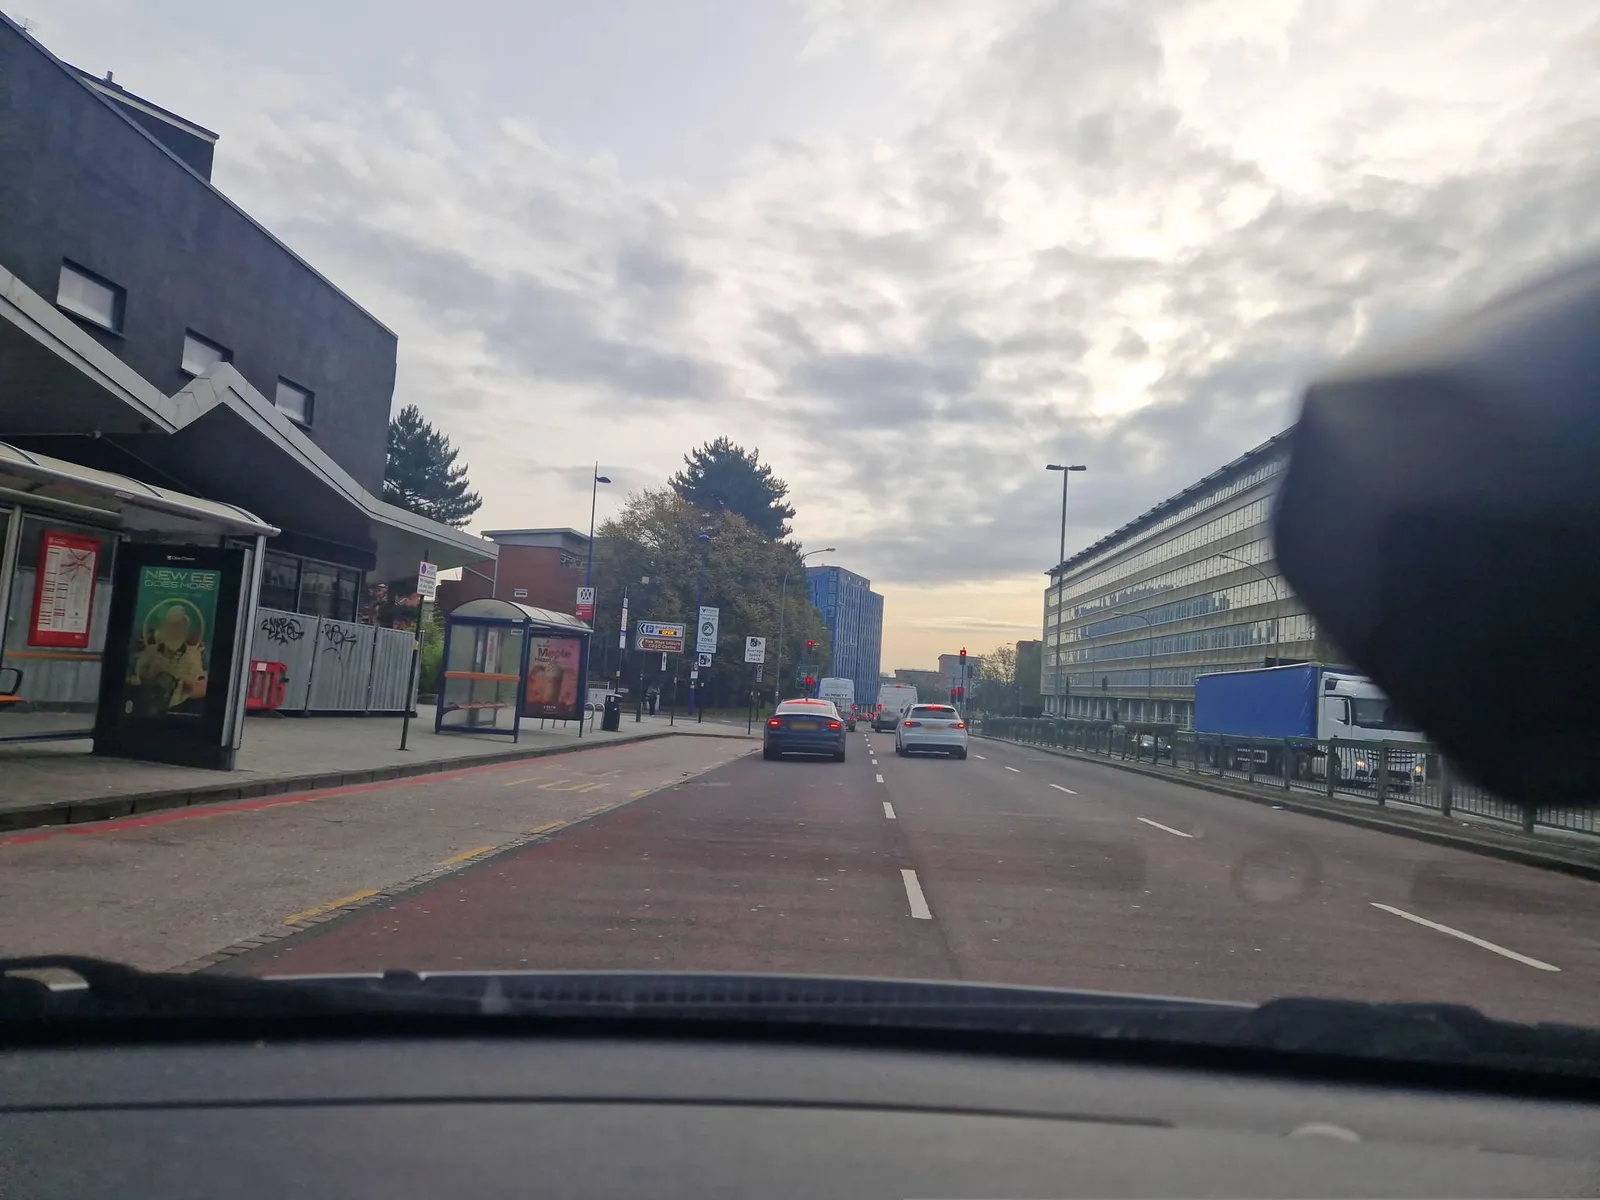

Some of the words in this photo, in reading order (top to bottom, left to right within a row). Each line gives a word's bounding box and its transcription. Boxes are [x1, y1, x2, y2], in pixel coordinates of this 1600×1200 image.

[146, 570, 188, 581] NEW
[191, 572, 216, 583] EE
[144, 580, 178, 588] DOES
[180, 582, 215, 591] MORE
